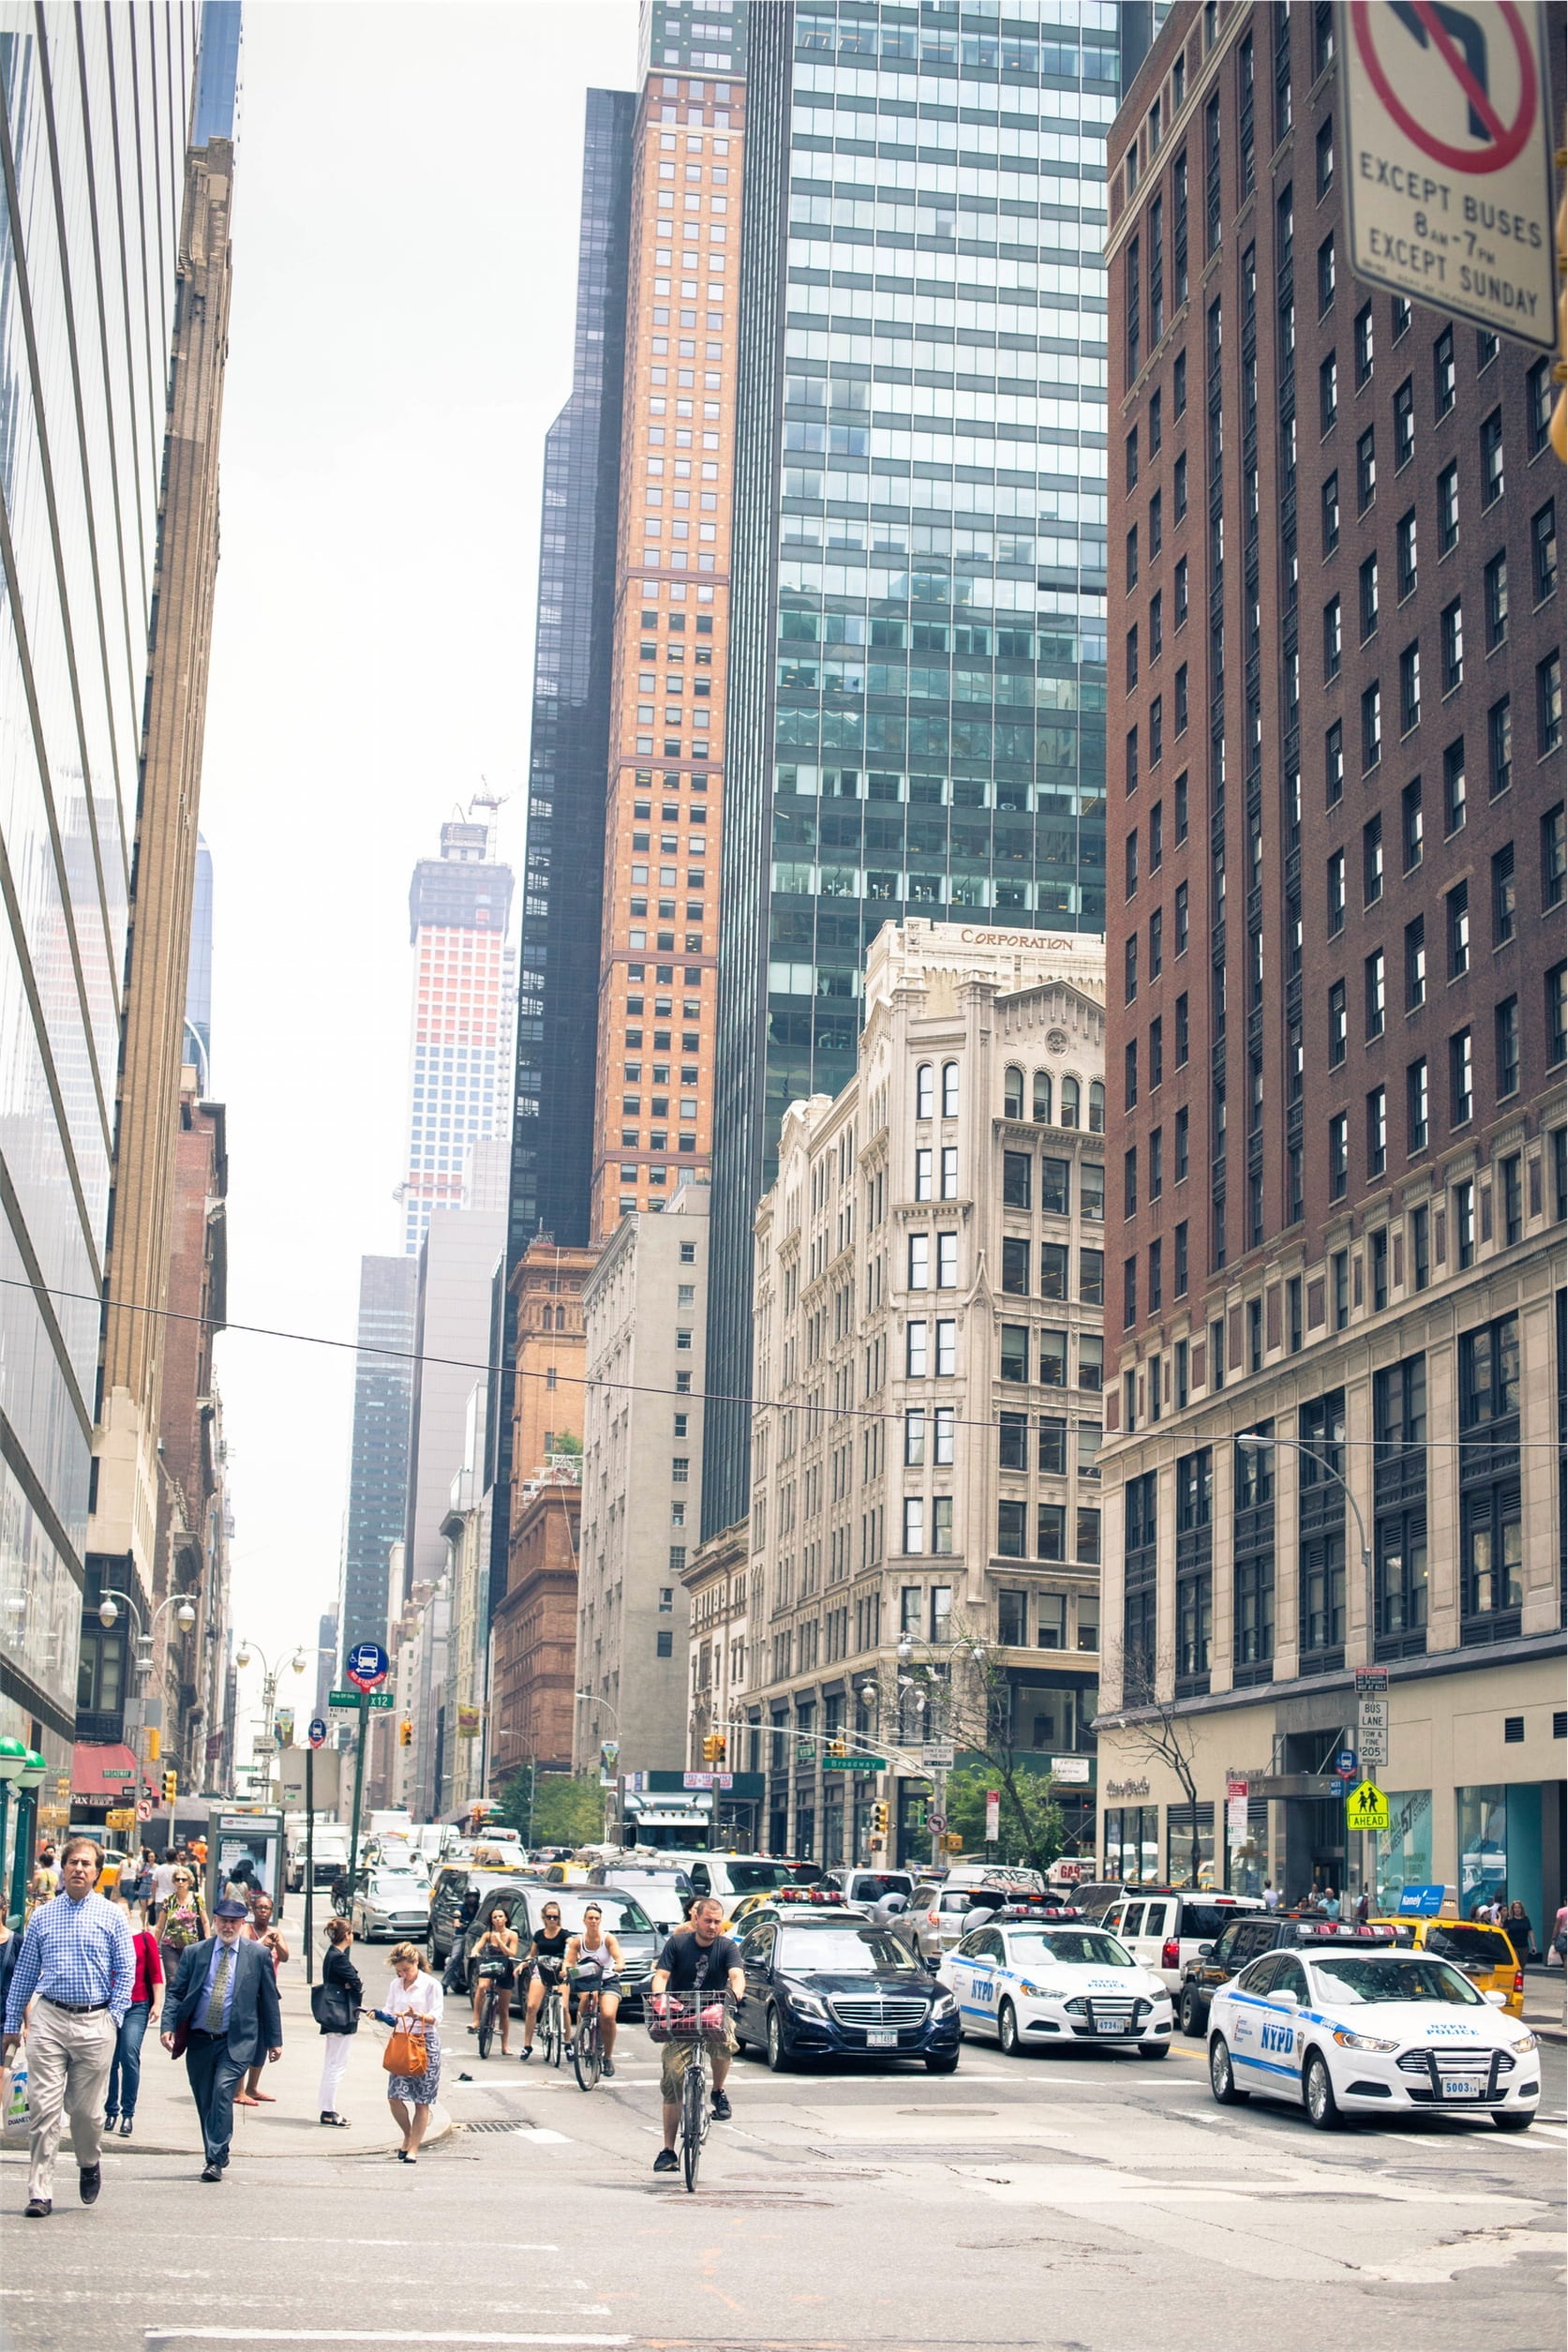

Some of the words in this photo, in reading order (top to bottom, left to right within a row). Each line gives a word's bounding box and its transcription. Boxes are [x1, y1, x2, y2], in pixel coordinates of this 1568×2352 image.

[1360, 152, 1451, 212] EXCEPT
[1463, 195, 1543, 250] BUSES
[1369, 228, 1448, 281] EXCEPT
[1459, 264, 1539, 318] SUNDAY
[961, 929, 1073, 951] CORPORATION
[1365, 1703, 1381, 1714] BUS
[1362, 1716, 1383, 1726] LANE
[831, 1760, 876, 1769] Broadway
[70, 1794, 88, 1805] Pax
[1353, 1816, 1384, 1827] AHEAD
[1401, 1895, 1423, 1909] Namely
[971, 1979, 994, 2003] NYPD
[1099, 2021, 1117, 2030] 4734
[1262, 2023, 1294, 2054] NYPD
[1446, 2082, 1470, 2093] 5003
